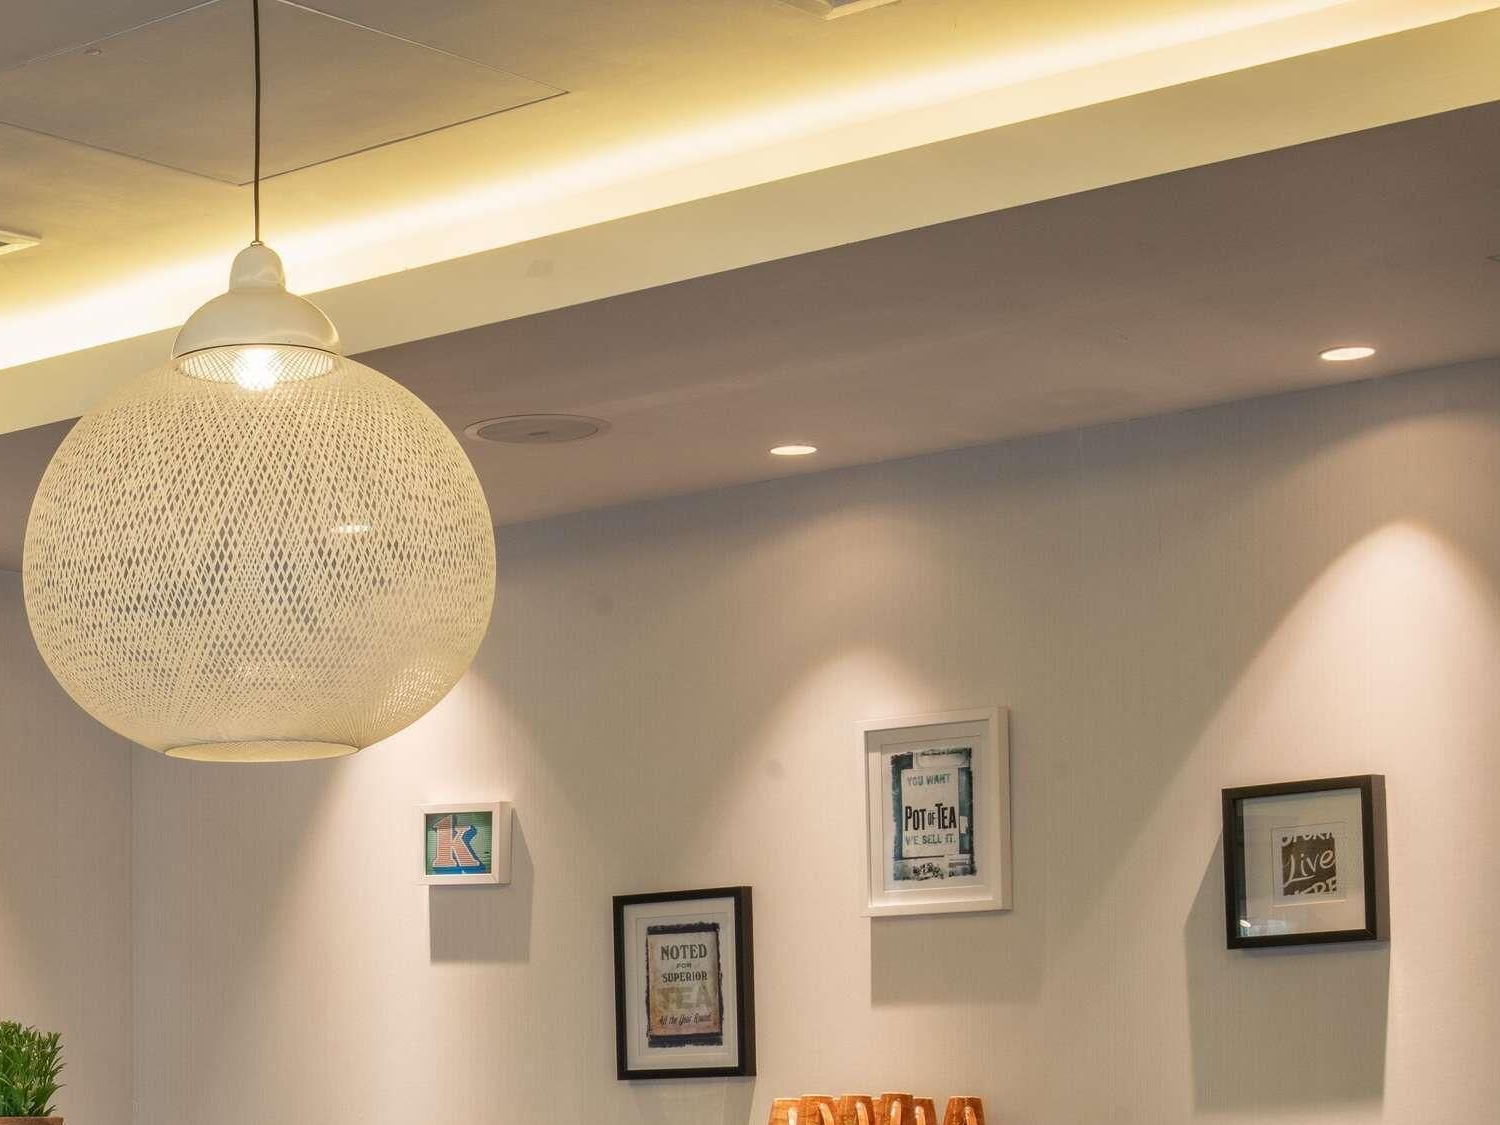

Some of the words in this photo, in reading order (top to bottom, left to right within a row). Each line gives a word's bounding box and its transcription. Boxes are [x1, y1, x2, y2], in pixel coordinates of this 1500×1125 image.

[906, 775, 924, 786] YOU
[926, 773, 950, 785] WANT
[904, 805, 926, 831] POT
[927, 812, 935, 826] OF
[935, 803, 957, 830] TEA
[905, 834, 919, 845] WE
[922, 834, 942, 845] SELL
[1283, 849, 1335, 888] Live
[660, 943, 708, 961] NOTED
[661, 970, 708, 983] SUPERIOR
